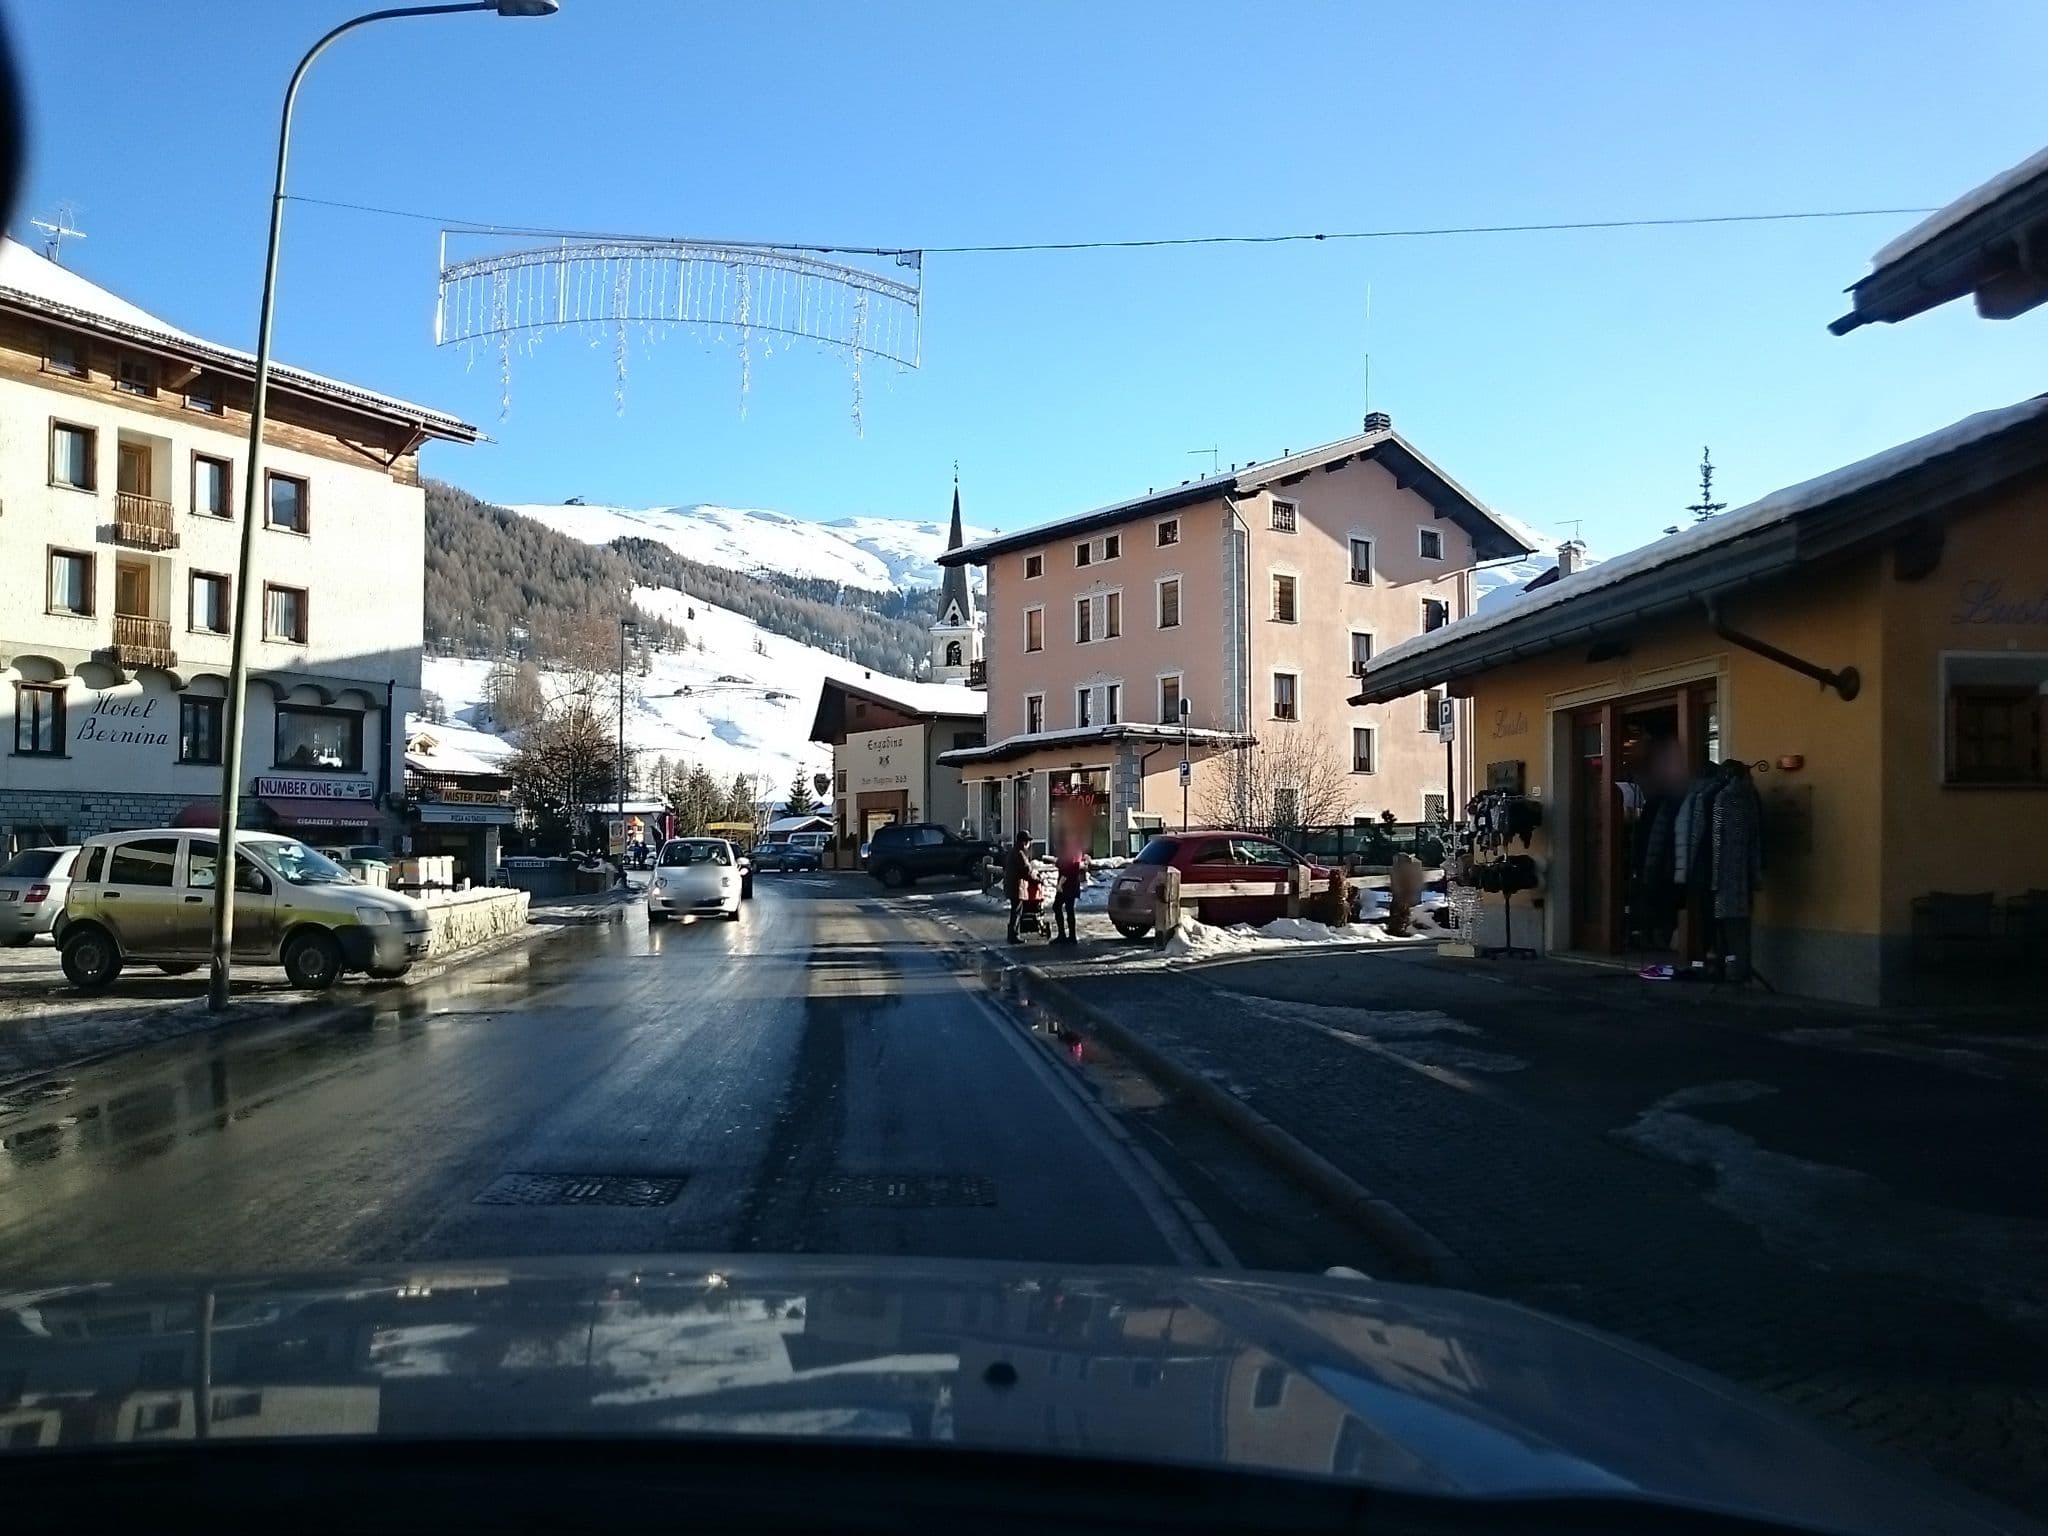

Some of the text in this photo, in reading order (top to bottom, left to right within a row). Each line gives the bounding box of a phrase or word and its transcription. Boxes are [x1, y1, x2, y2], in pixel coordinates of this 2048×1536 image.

[92, 691, 157, 719] Hotel
[1442, 703, 1450, 723] P
[76, 717, 168, 745] Bernina
[260, 780, 332, 797] NUMBER ONE
[444, 791, 473, 802] MISTER
[475, 793, 498, 804] PIZZA
